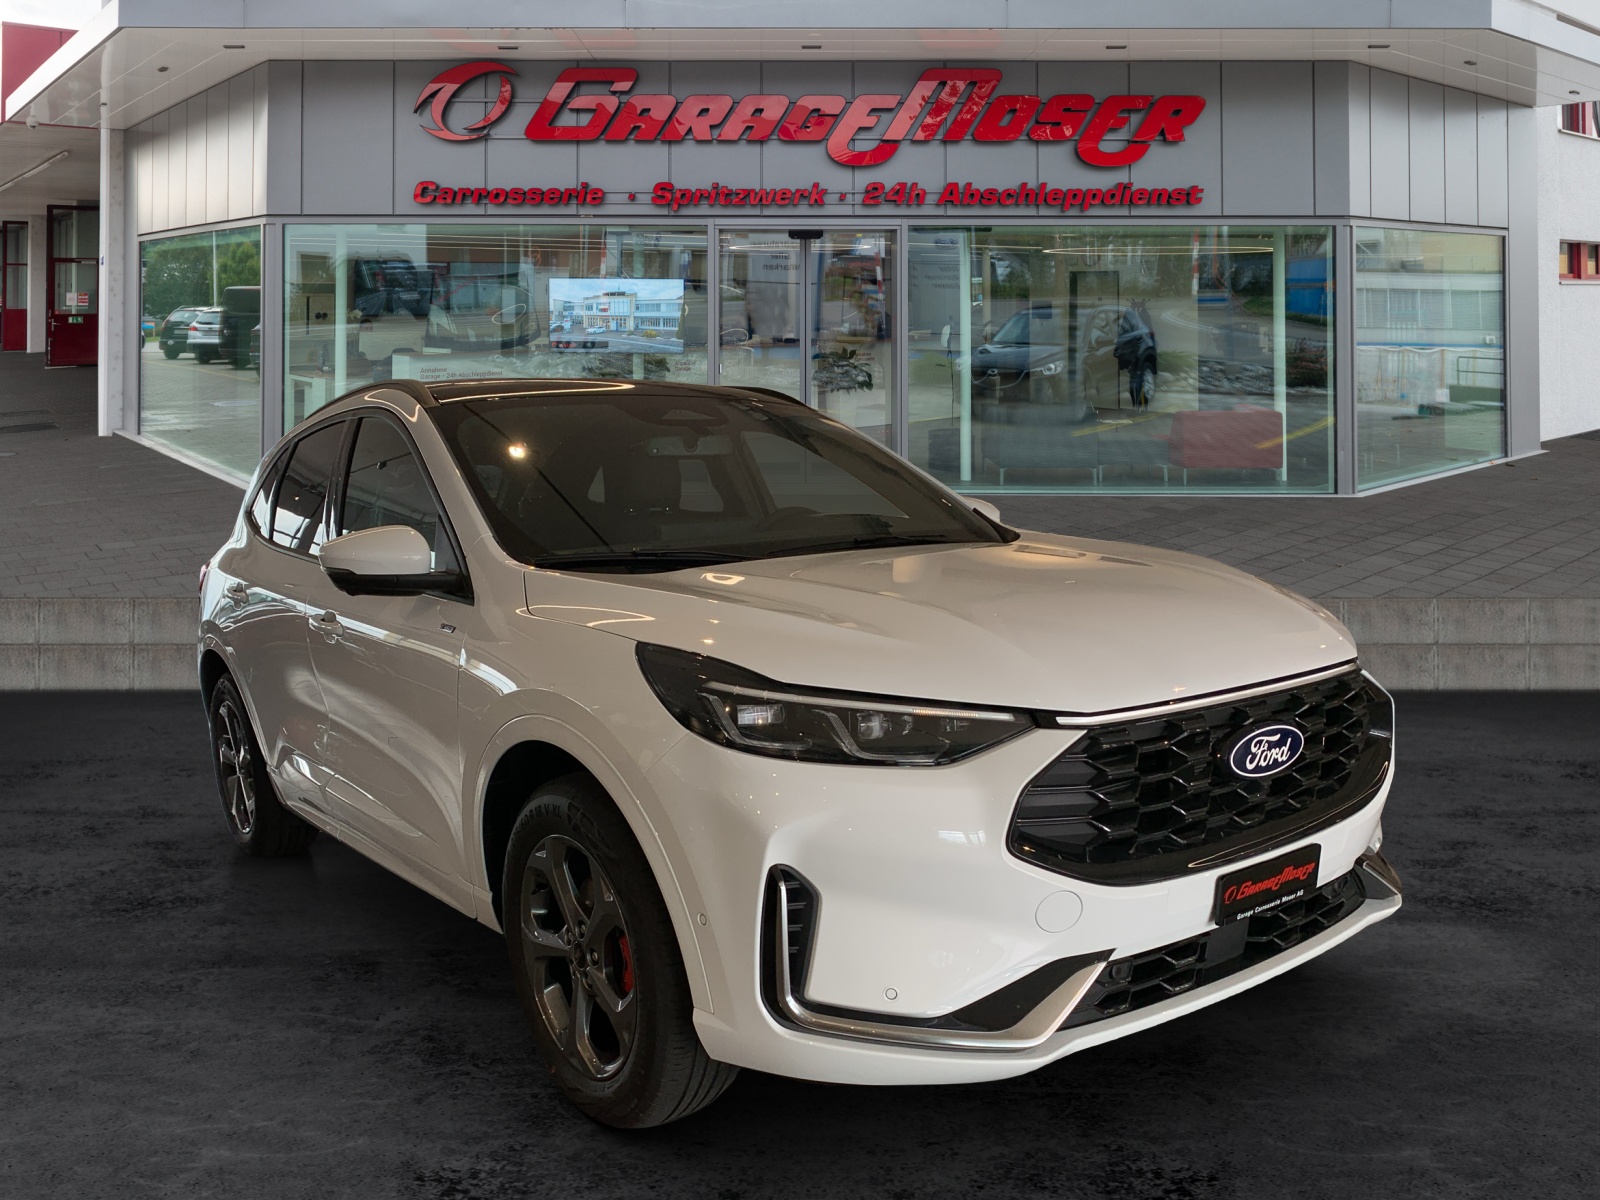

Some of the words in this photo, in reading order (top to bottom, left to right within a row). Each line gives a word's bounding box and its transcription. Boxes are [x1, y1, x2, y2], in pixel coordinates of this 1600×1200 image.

[413, 180, 604, 205] Carrosserie
[651, 181, 827, 211] Spritzwerk
[862, 182, 927, 205] 24h
[937, 181, 1204, 211] Abschleppdienst
[458, 370, 503, 379] Abschleppdienst
[1246, 733, 1292, 770] Ford
[1236, 909, 1254, 920] Garage
